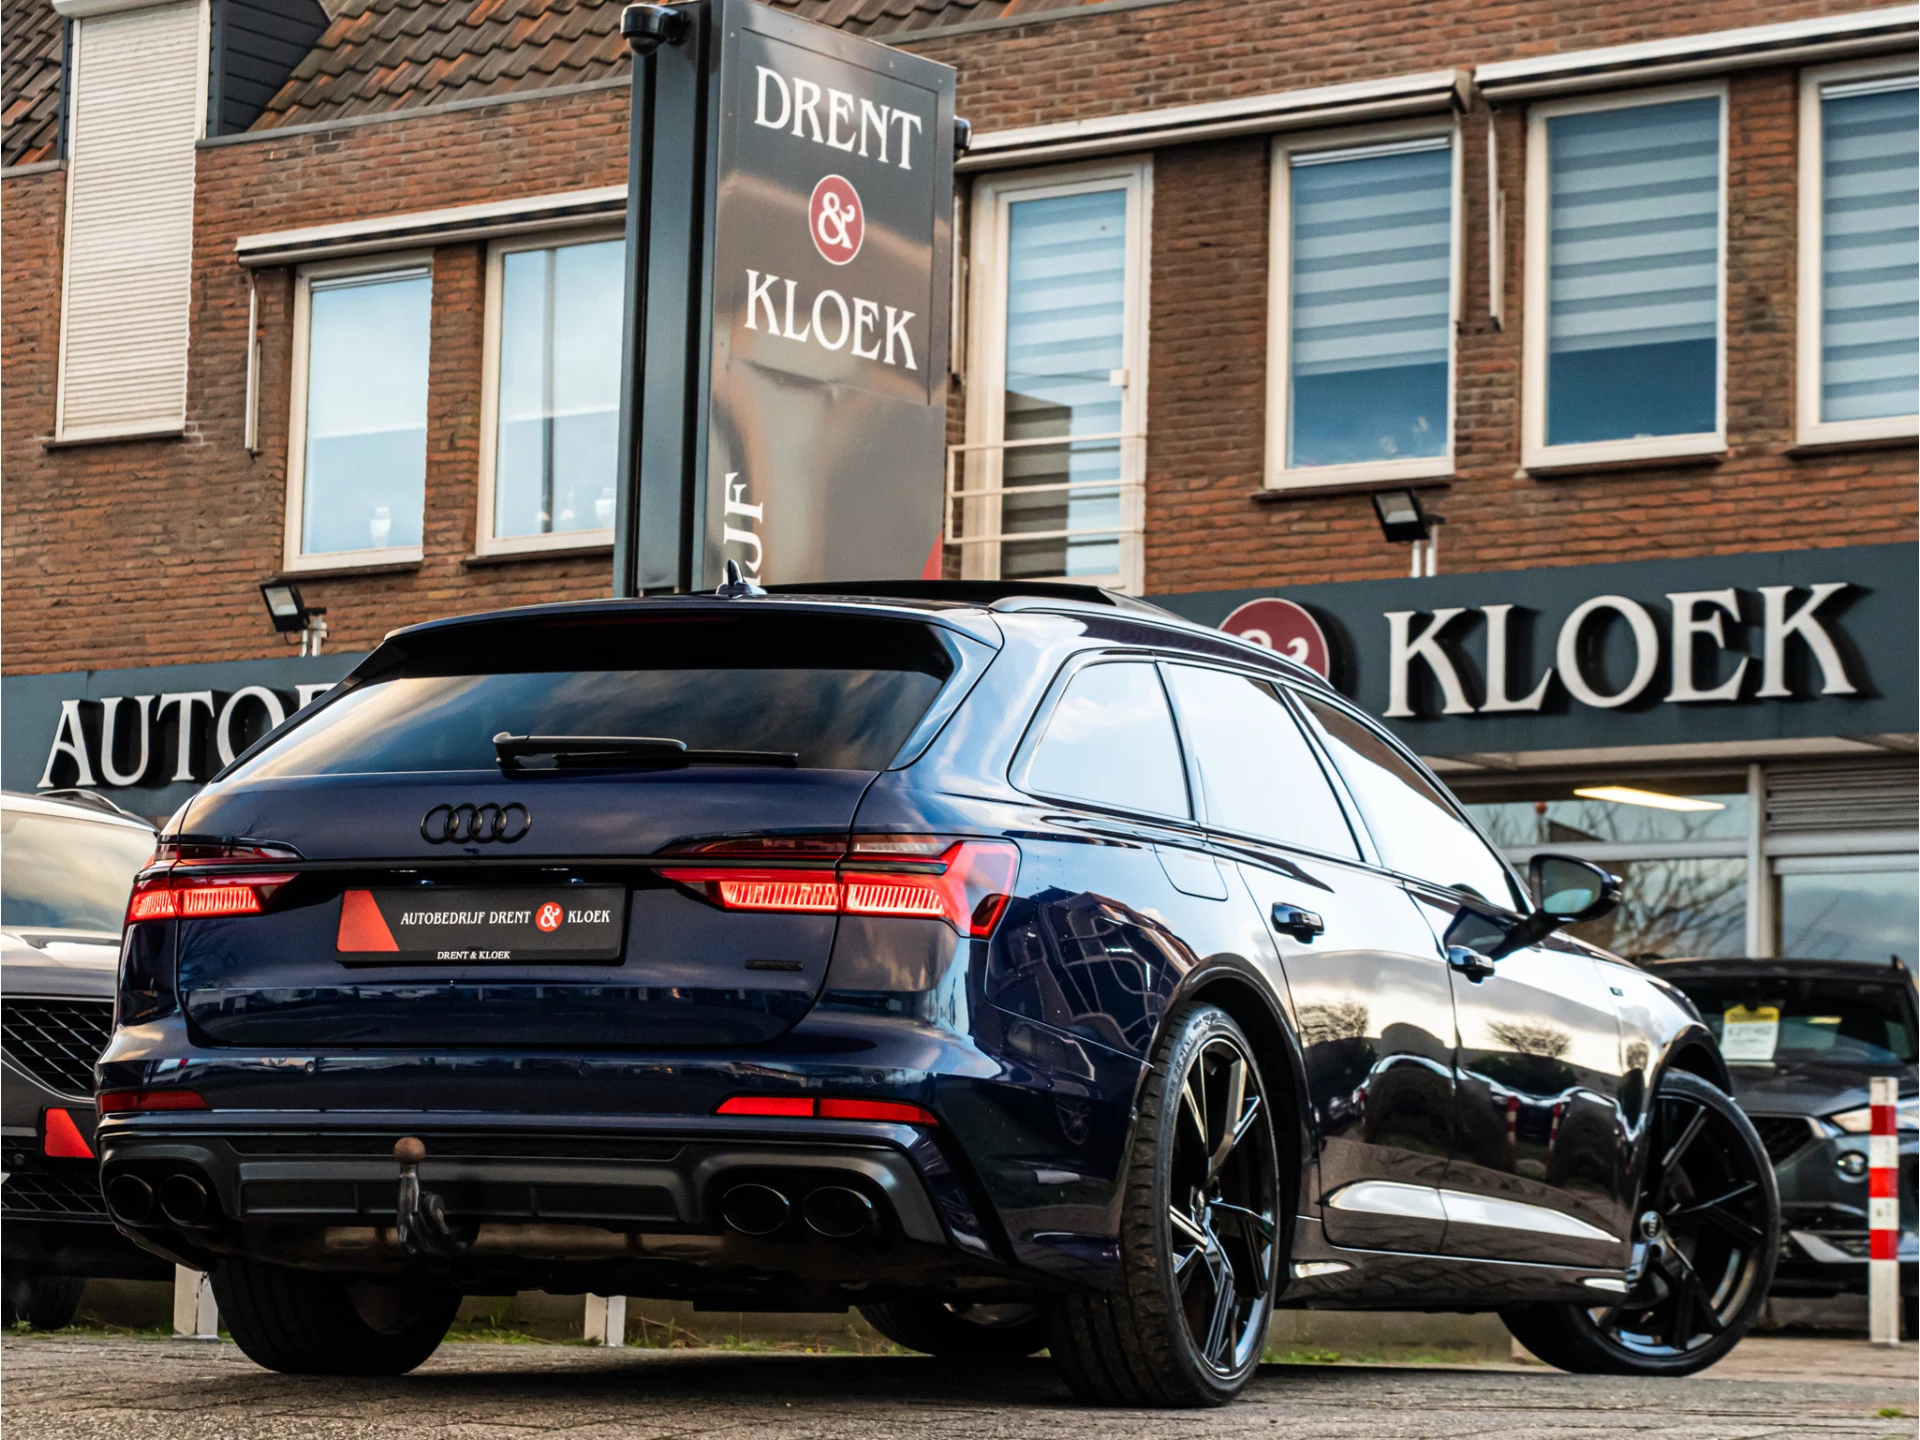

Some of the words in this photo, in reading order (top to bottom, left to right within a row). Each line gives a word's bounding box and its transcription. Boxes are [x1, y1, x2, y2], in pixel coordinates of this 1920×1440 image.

[754, 65, 922, 170] DRENT
[817, 191, 856, 249] &
[744, 268, 918, 371] KLOEK
[1382, 582, 1858, 718] KLOEK
[400, 911, 486, 924] AUTOBEDRIJF
[488, 910, 532, 924] DRENT
[539, 905, 560, 927] &
[567, 909, 611, 923] KLOEK
[437, 951, 468, 960] DRENT
[469, 951, 477, 960] &
[479, 951, 511, 960] KLOEK
